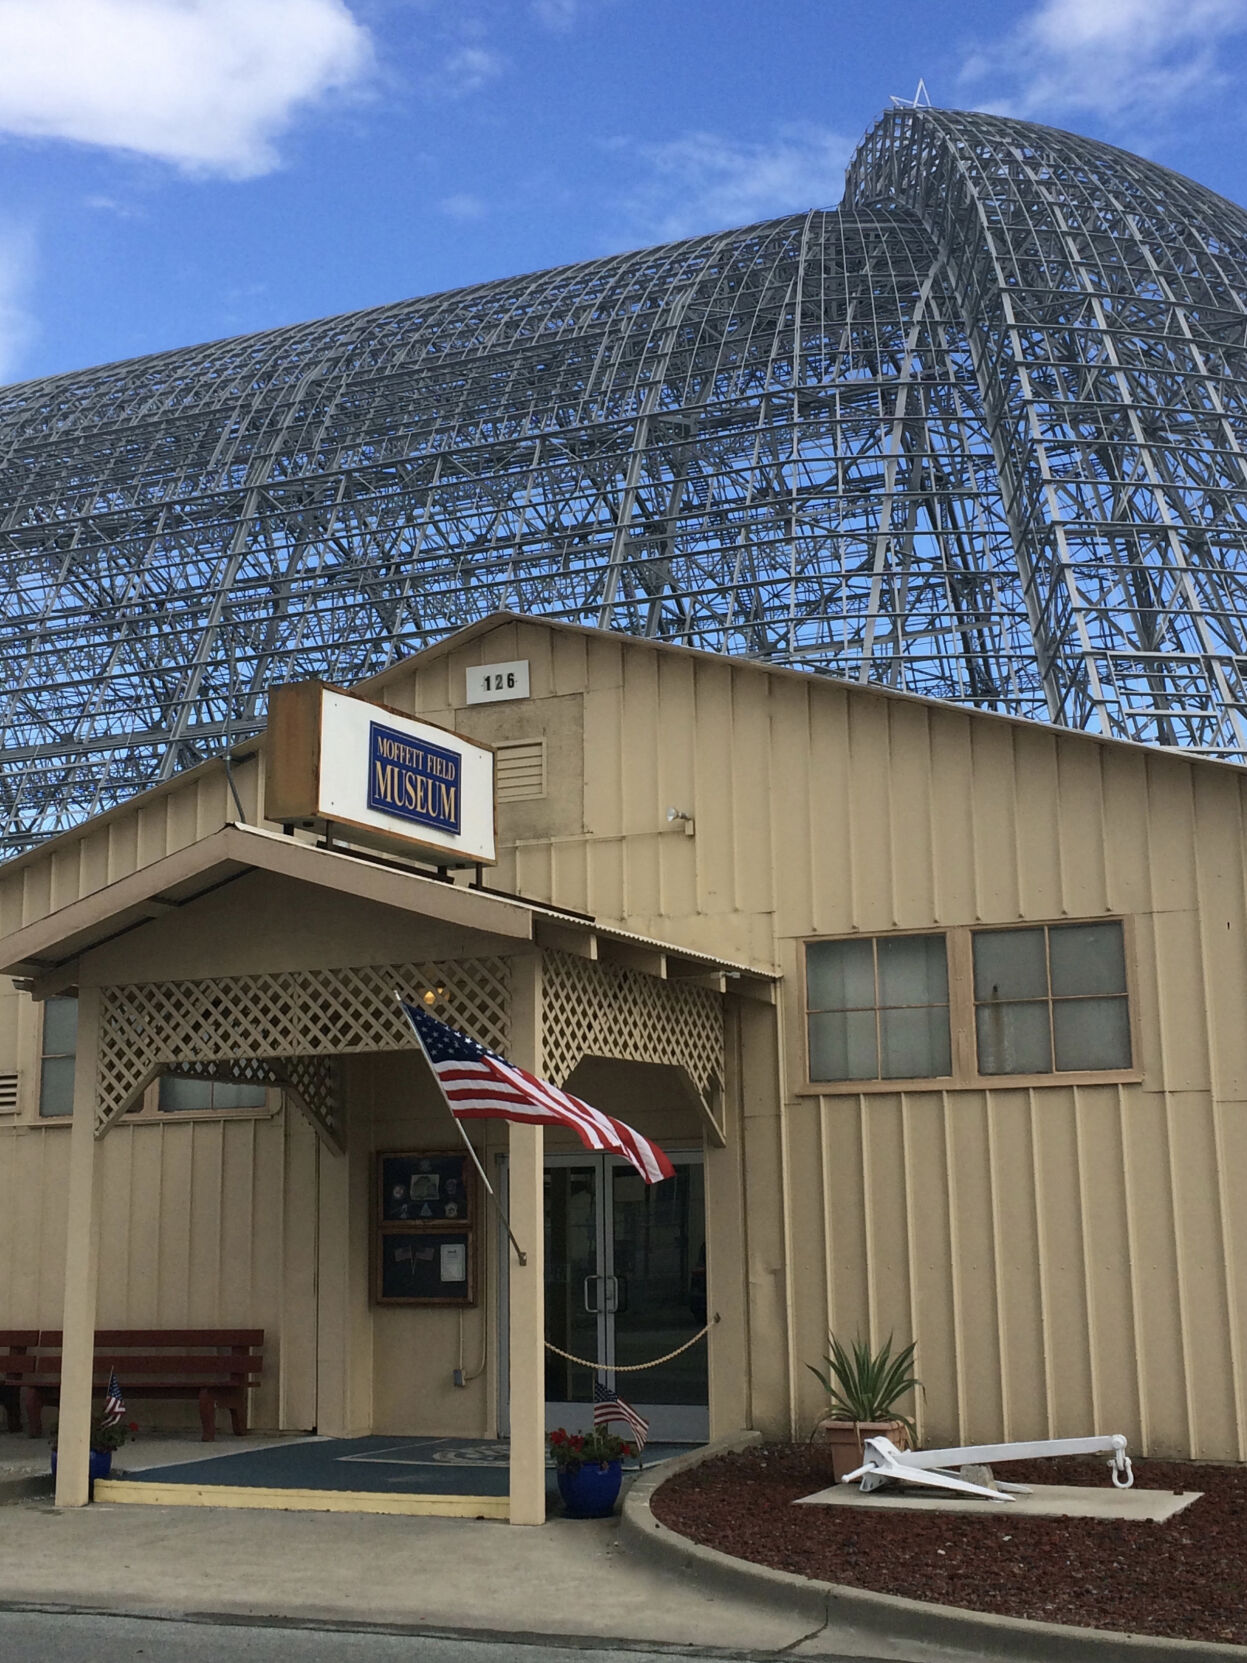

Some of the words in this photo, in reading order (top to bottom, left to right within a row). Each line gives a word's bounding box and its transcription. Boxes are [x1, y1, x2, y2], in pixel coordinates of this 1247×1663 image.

[484, 672, 515, 691] 126
[377, 736, 424, 769] MOFFETT
[427, 754, 456, 781] FIELD
[374, 760, 456, 823] MUSEUM
